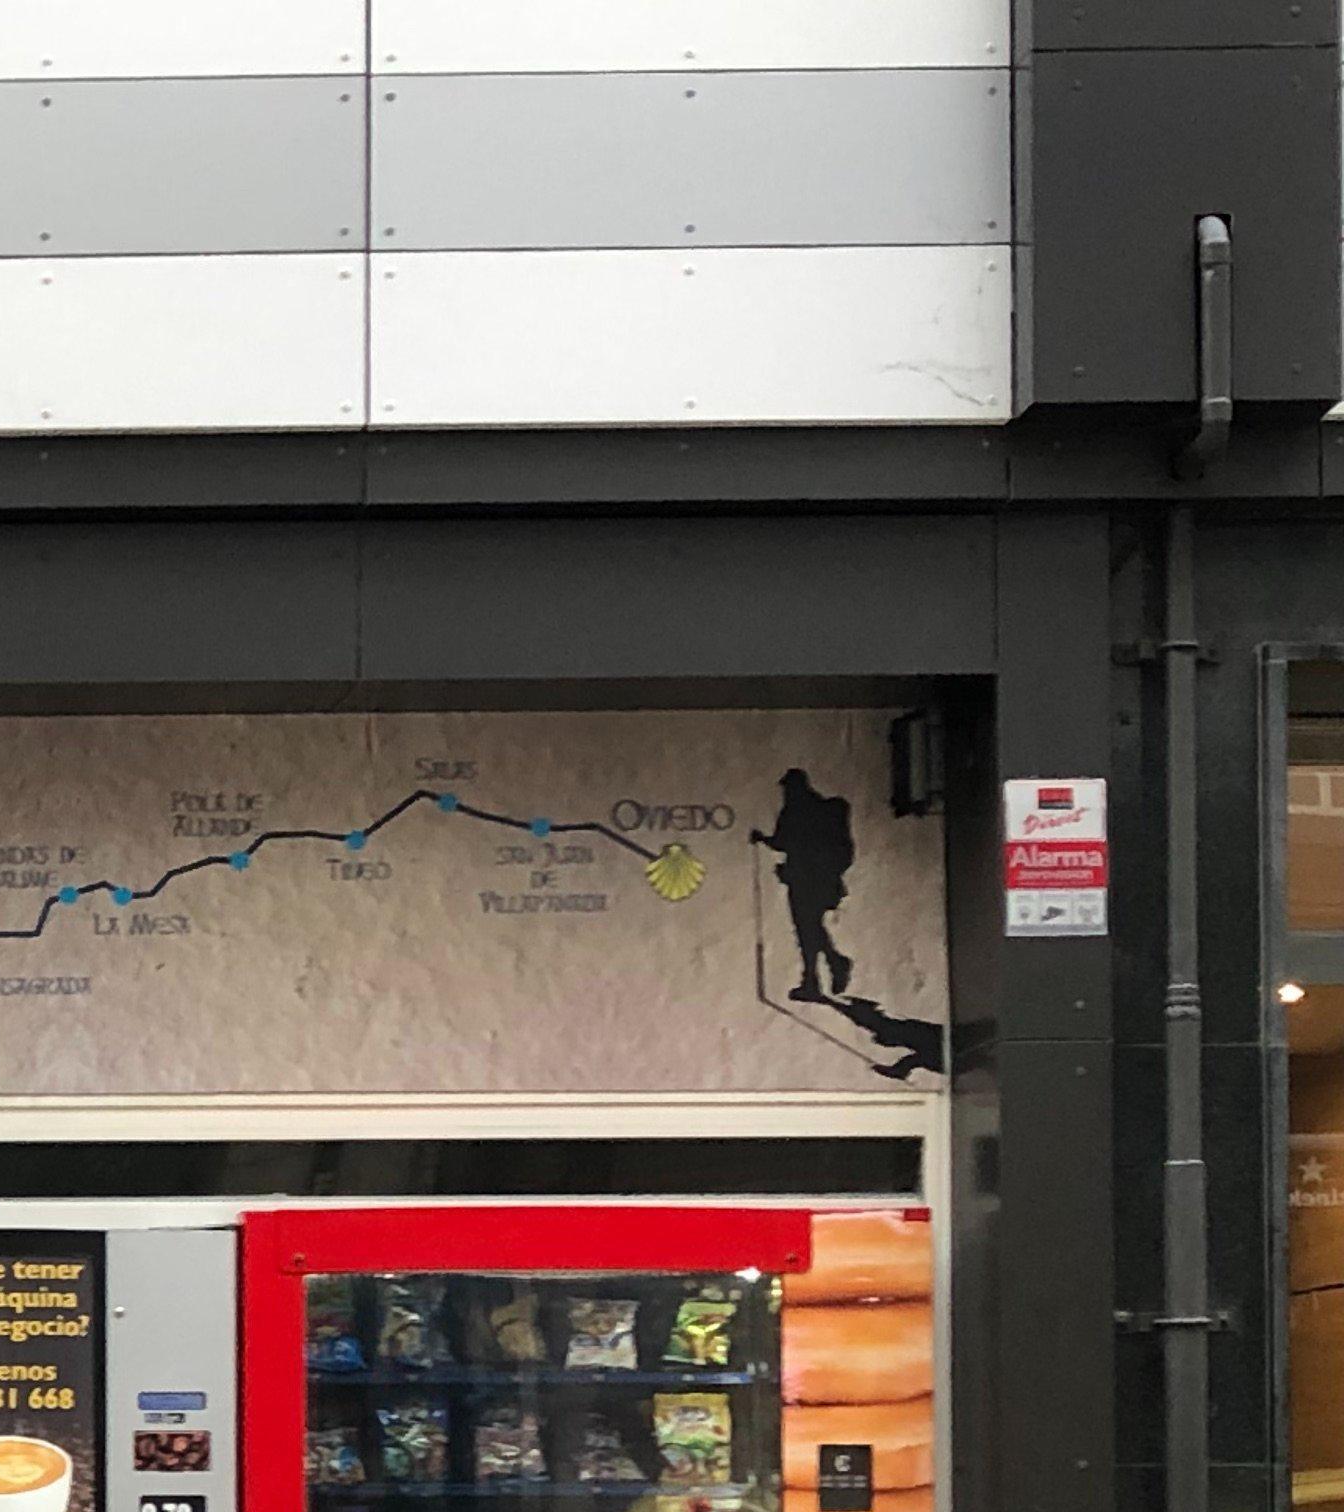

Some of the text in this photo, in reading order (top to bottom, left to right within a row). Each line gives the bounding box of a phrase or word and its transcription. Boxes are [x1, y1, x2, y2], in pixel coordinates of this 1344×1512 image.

[613, 799, 735, 832] OVIEDO
[1010, 845, 1103, 868] Alarma
[13, 1260, 85, 1279] tener
[28, 1387, 76, 1410] 668
